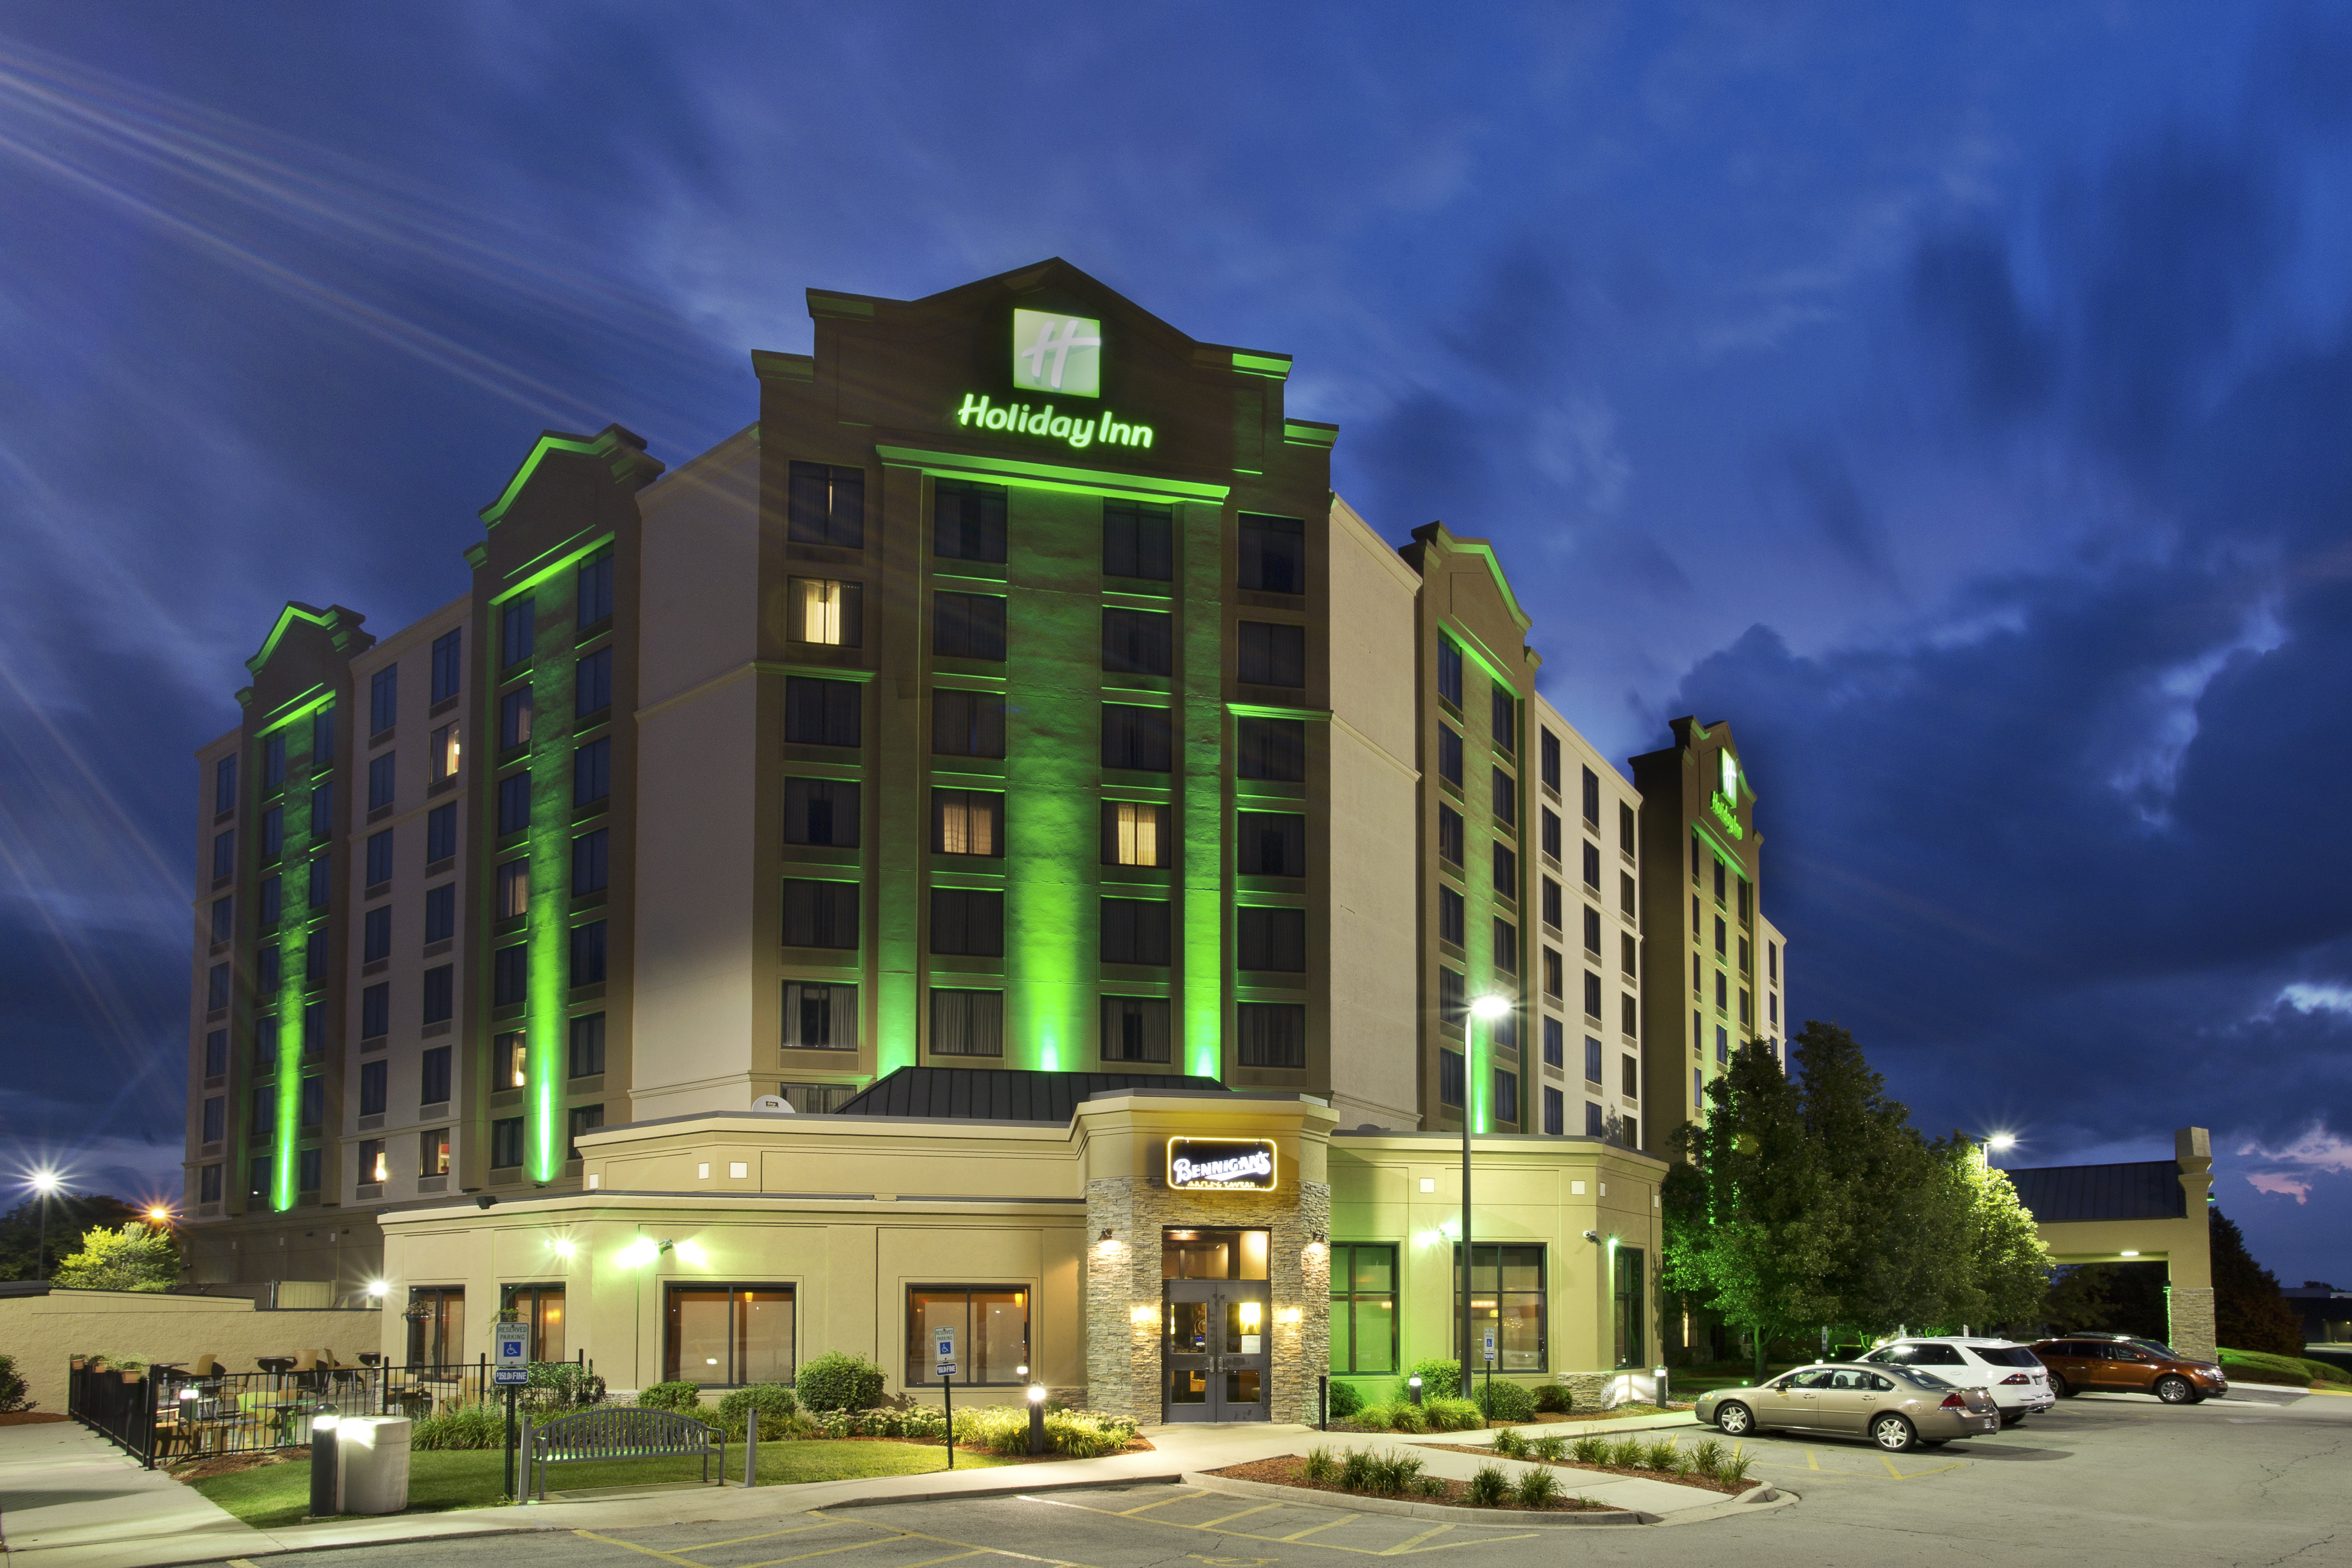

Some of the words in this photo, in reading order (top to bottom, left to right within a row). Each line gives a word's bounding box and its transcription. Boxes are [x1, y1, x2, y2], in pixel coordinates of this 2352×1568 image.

[958, 393, 1094, 447] Holiday
[1099, 411, 1152, 448] Inn
[1711, 790, 1734, 834] Holiday
[1733, 815, 1742, 840] Inn
[1173, 1151, 1271, 1183] BENNIGAN'S
